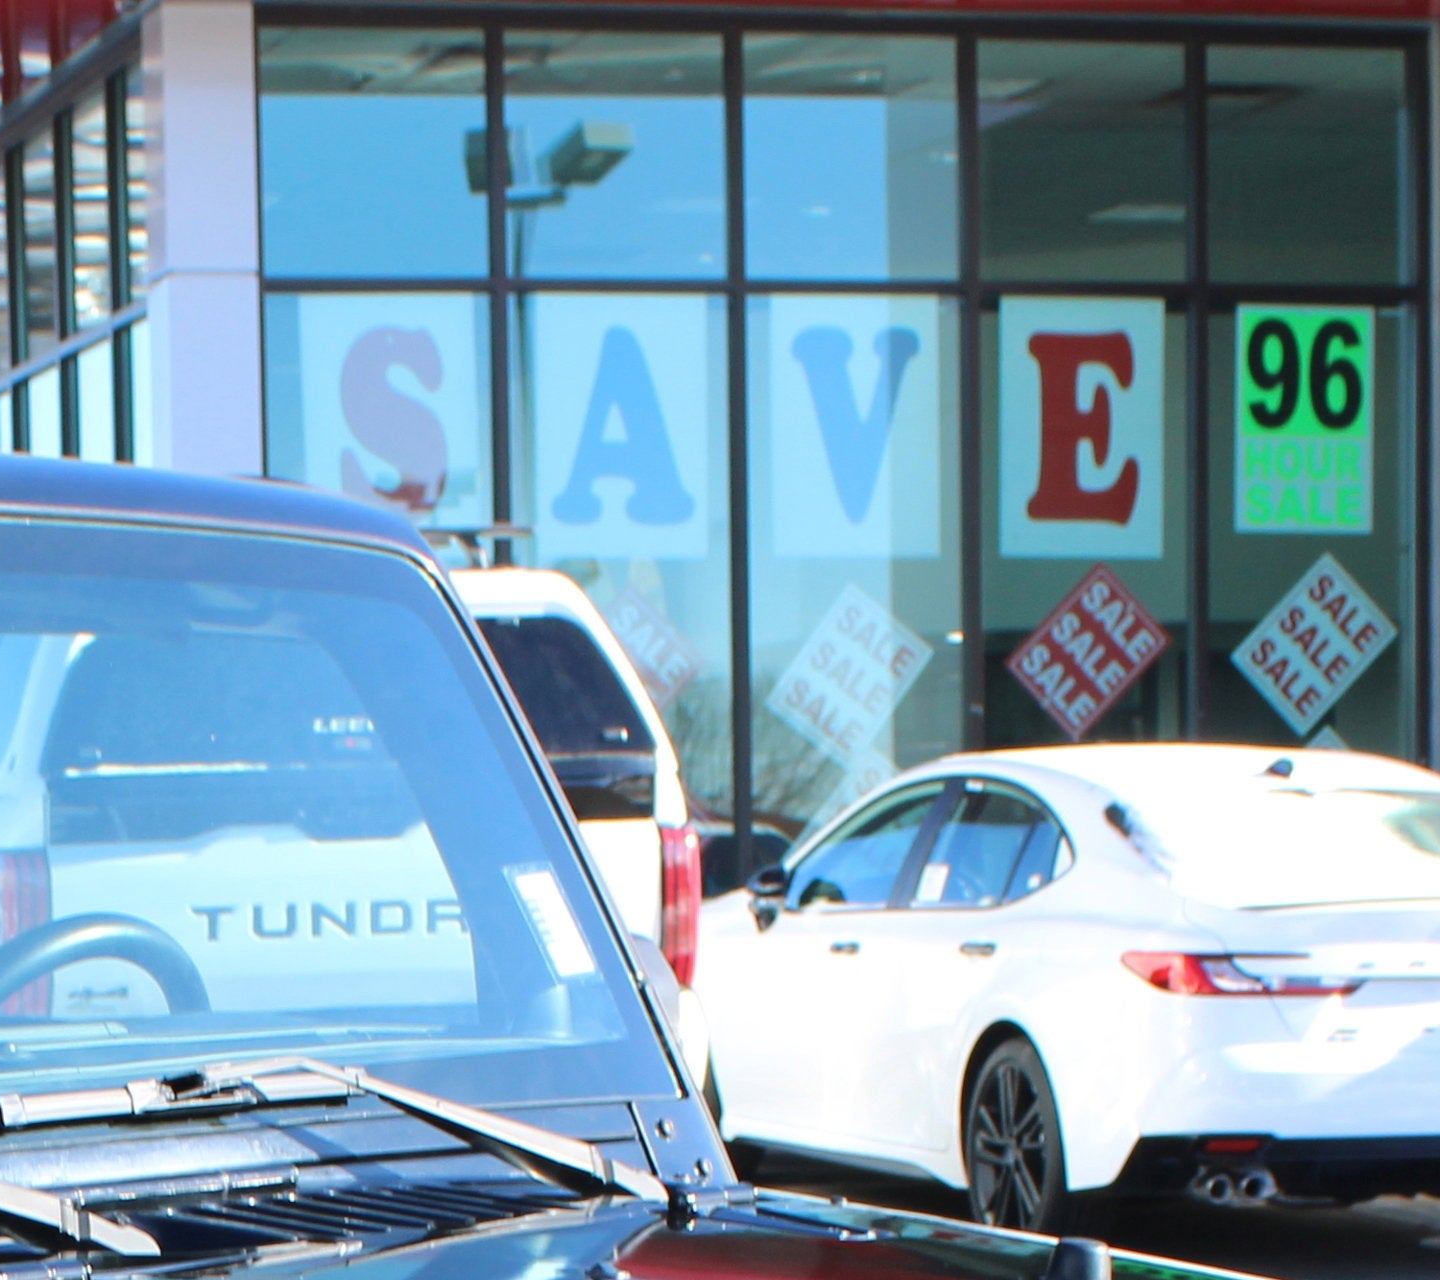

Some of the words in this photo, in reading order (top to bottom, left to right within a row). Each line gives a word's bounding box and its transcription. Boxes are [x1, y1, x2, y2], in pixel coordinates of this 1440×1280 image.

[1247, 318, 1364, 431] 96
[338, 324, 1140, 527] SAVE
[1245, 443, 1361, 482] HOUR
[1245, 485, 1364, 526] SALE
[836, 606, 915, 679] SALE
[1081, 581, 1156, 664] SALE
[1279, 606, 1350, 684] SALE
[1308, 573, 1381, 654] SALE
[810, 645, 891, 715] SALE
[1022, 644, 1096, 728] SALE
[1051, 613, 1124, 696] SALE
[1251, 639, 1321, 717] SALE
[786, 681, 864, 752] SALE
